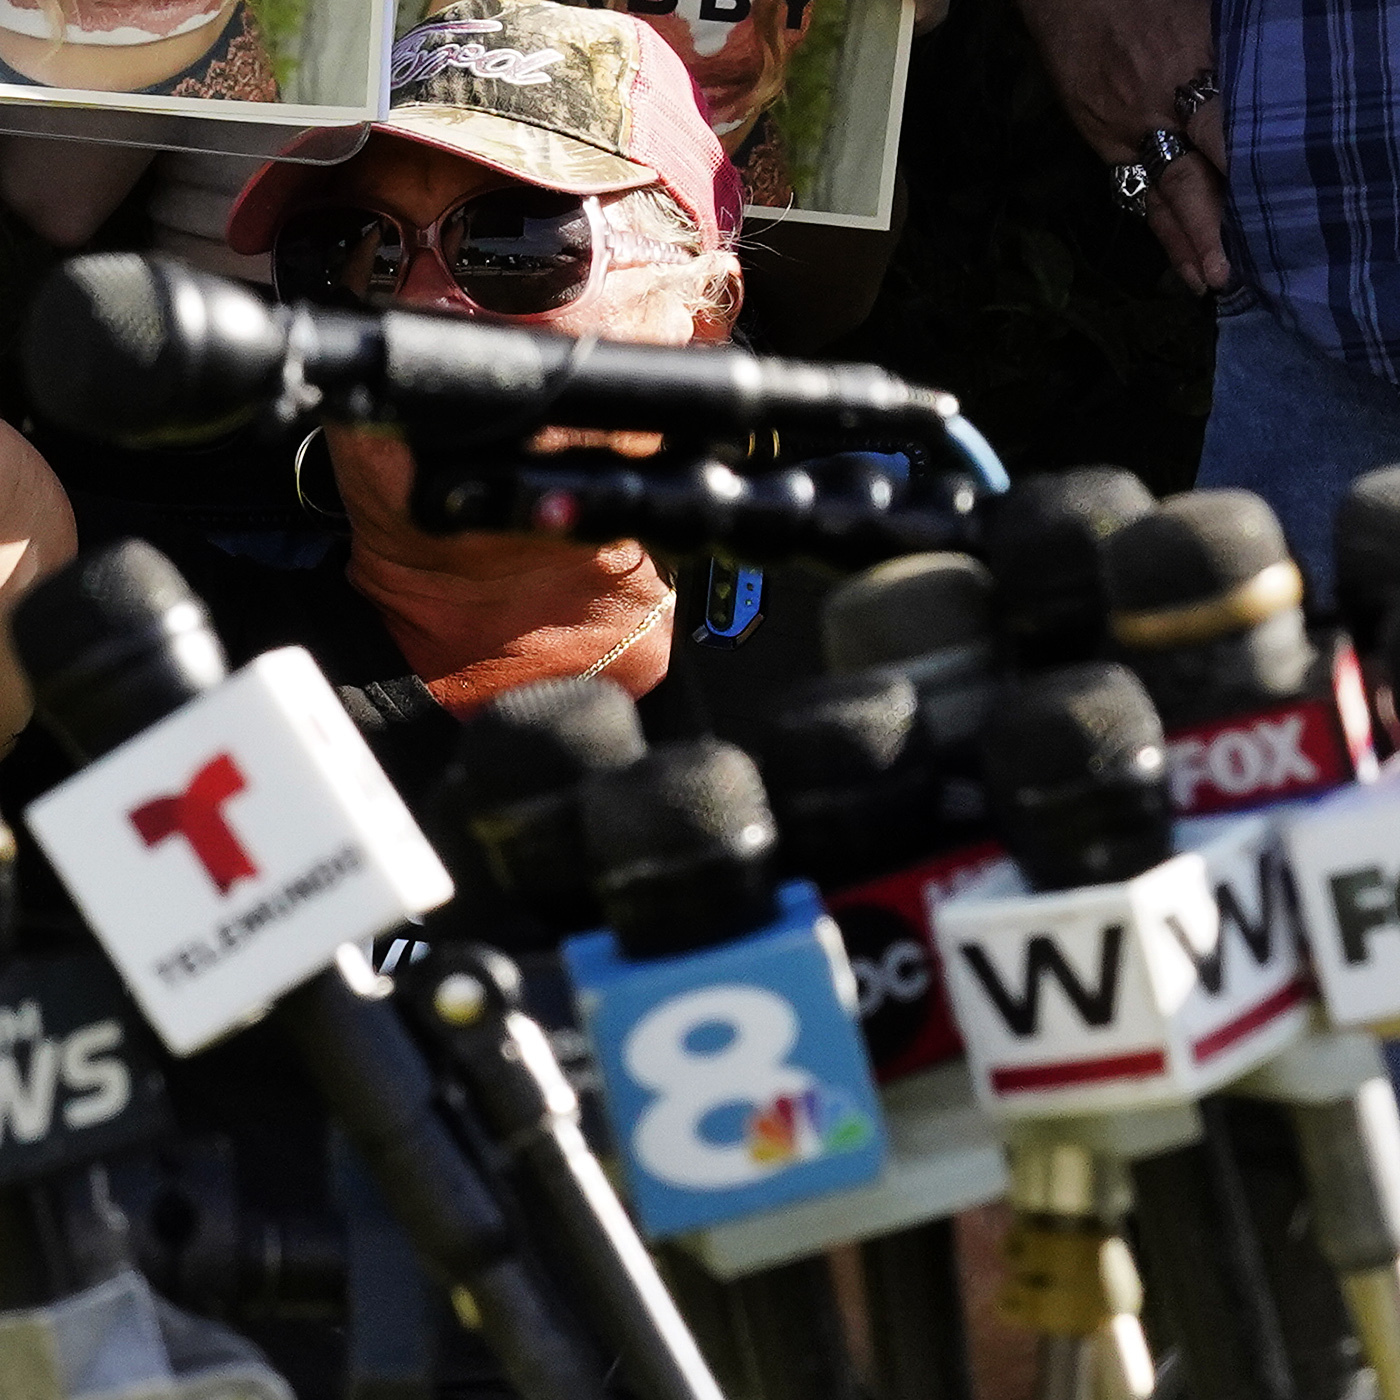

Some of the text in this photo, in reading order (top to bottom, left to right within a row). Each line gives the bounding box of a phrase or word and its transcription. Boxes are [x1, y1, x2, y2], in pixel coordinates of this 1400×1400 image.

[1166, 712, 1320, 808] FOX
[1328, 865, 1400, 968] F
[962, 924, 1126, 1038] W
[622, 983, 812, 1192] 8
